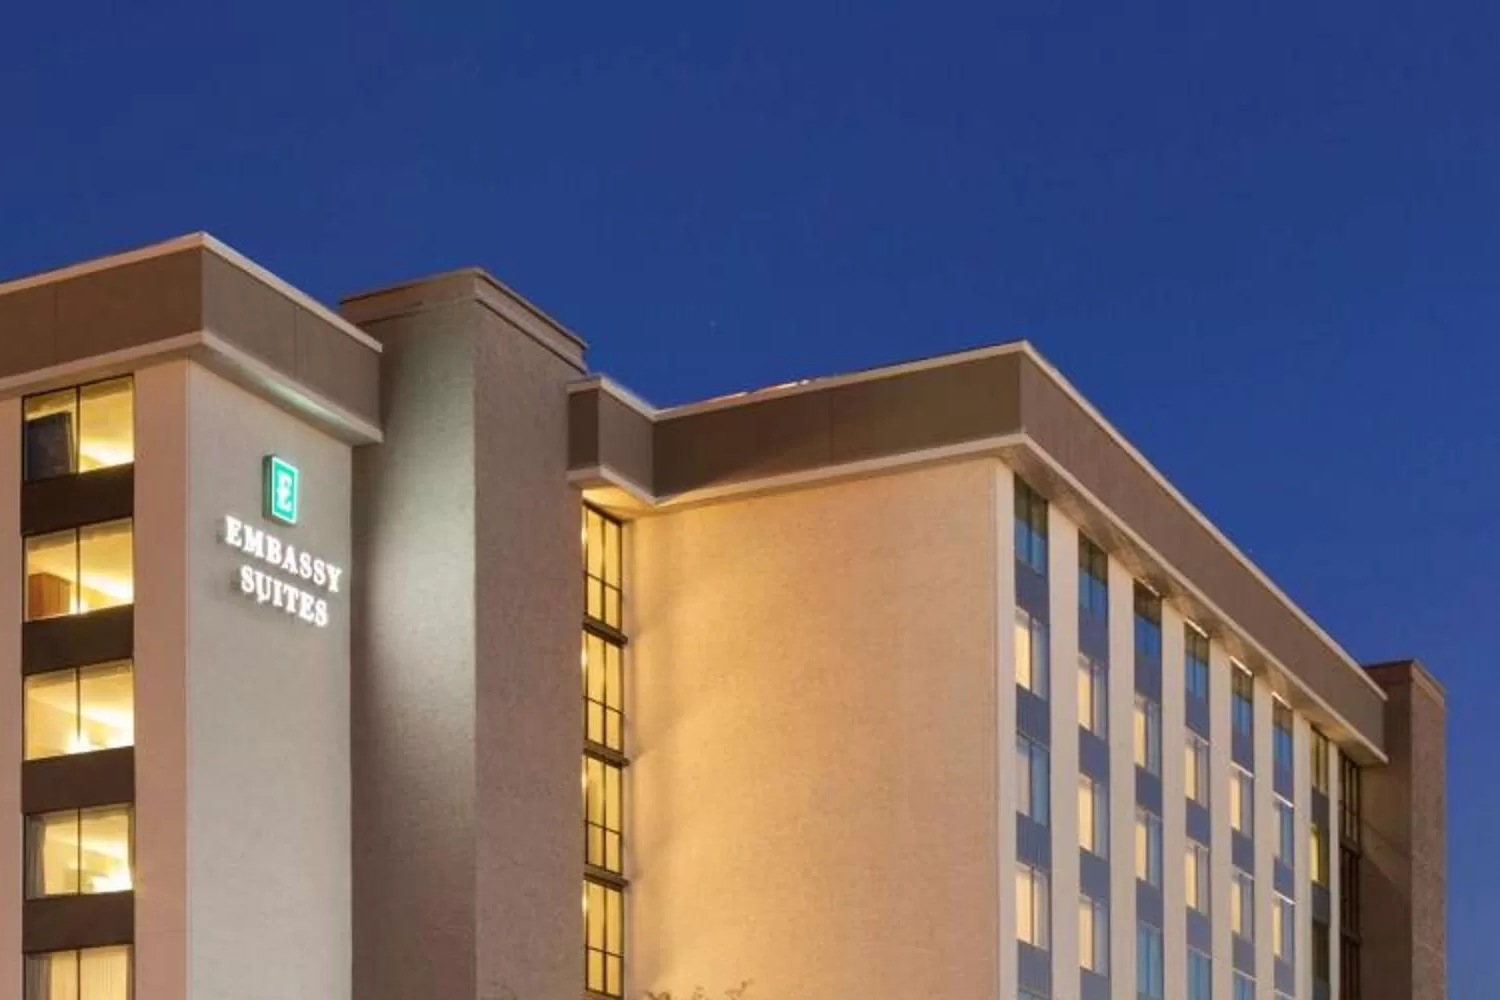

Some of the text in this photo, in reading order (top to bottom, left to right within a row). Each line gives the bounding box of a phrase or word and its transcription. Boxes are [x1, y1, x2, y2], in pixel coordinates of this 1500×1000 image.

[276, 471, 293, 511] E
[225, 514, 342, 592] EMBASSY
[240, 565, 328, 627] SUITES
